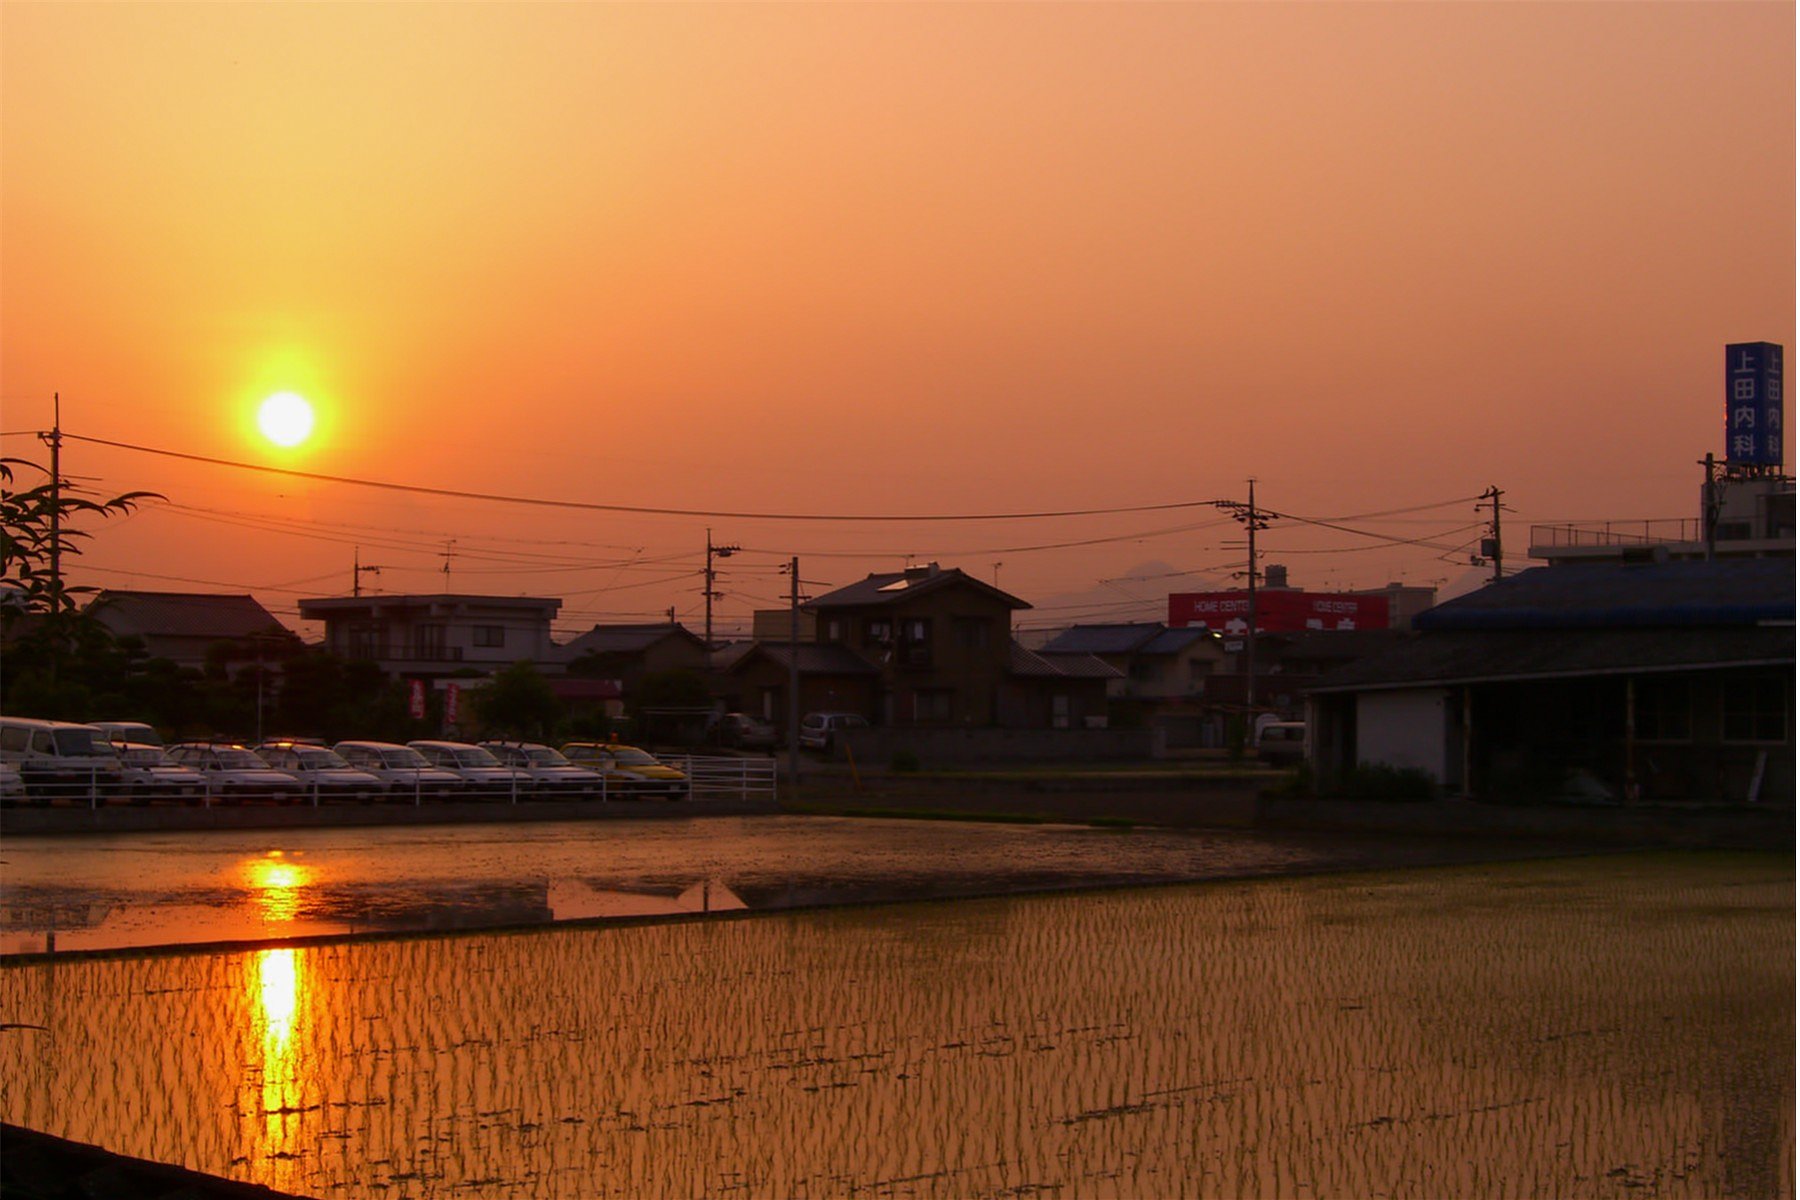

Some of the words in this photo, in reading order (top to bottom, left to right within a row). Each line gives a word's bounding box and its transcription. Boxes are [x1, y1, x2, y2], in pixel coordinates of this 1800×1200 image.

[1734, 350, 1756, 457] 上田内科
[1767, 351, 1780, 457] 上田内科
[1194, 600, 1218, 613] HOME
[1220, 600, 1251, 613] CENTE
